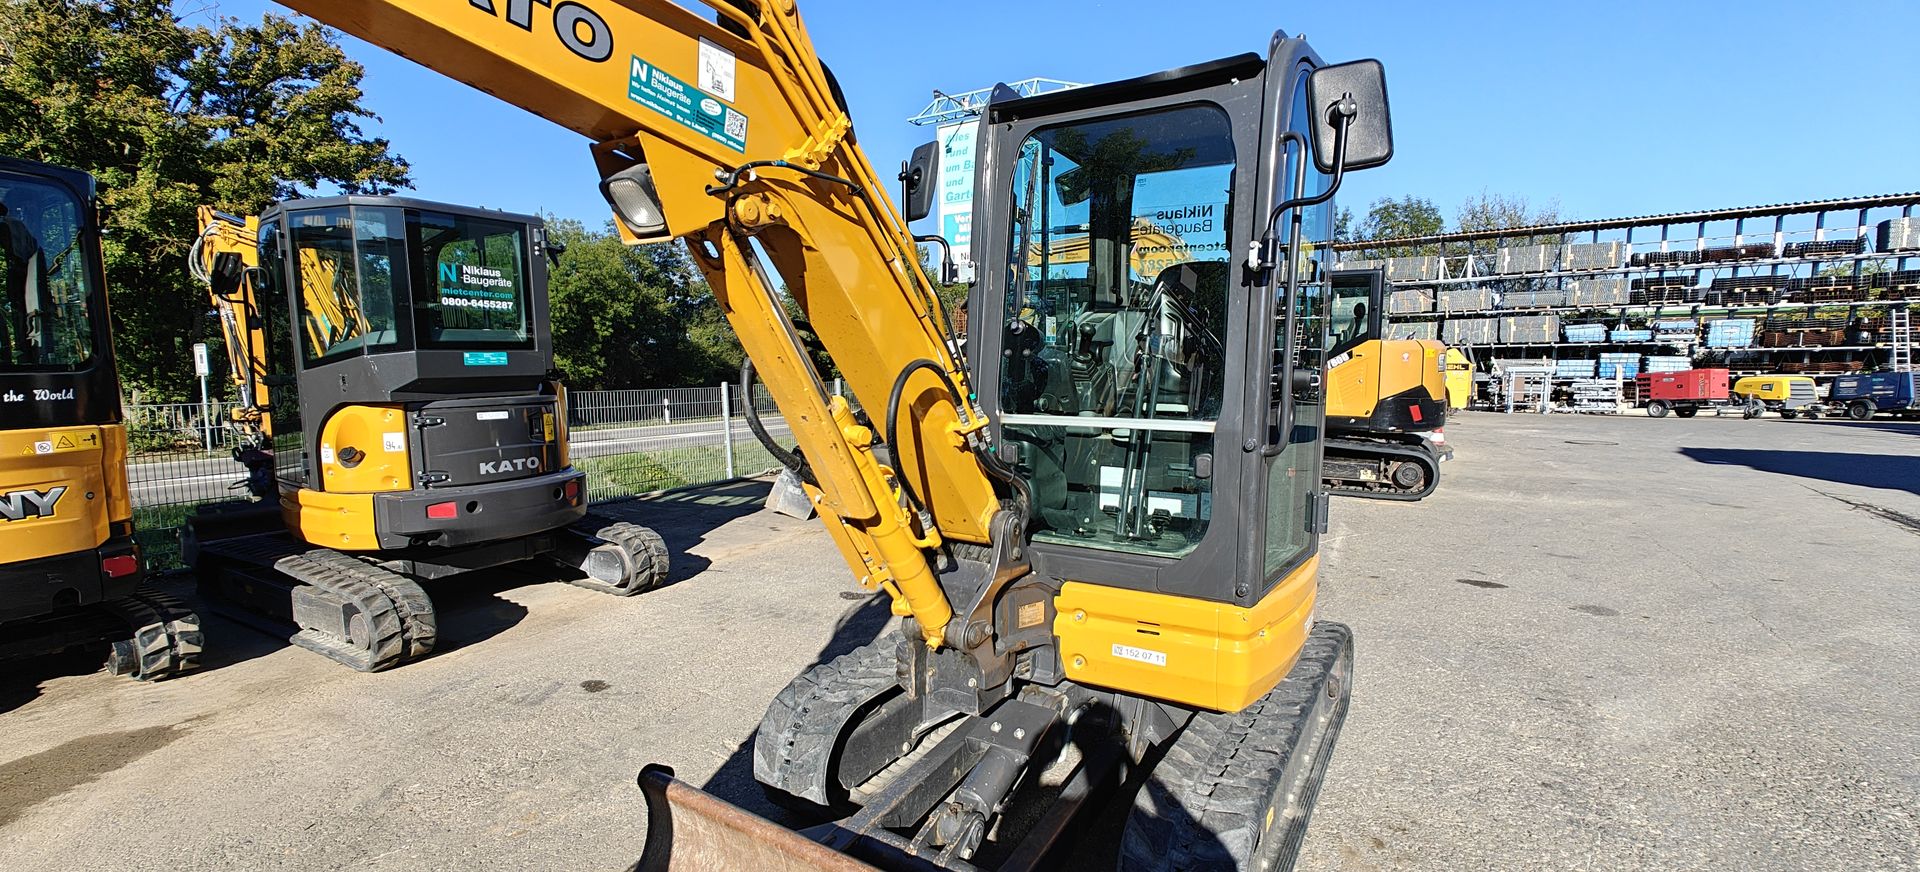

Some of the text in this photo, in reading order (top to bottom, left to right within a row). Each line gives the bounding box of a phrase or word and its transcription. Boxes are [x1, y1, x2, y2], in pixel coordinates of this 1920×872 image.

[468, 0, 614, 63] TO
[652, 68, 684, 93] Niklaus
[651, 78, 692, 106] Baugeräte
[946, 147, 968, 158] und
[946, 163, 960, 173] um
[946, 176, 964, 187] und
[440, 262, 457, 283] N
[462, 265, 501, 278] Niklaus
[462, 274, 512, 288] Baugeräte
[441, 287, 513, 299] mietcenter.com
[441, 297, 514, 310] 0800-6455287
[3, 388, 75, 402] the World
[385, 440, 396, 450] 94
[479, 456, 540, 475] KATO
[1126, 648, 1140, 658] 152
[1142, 651, 1153, 661] 07
